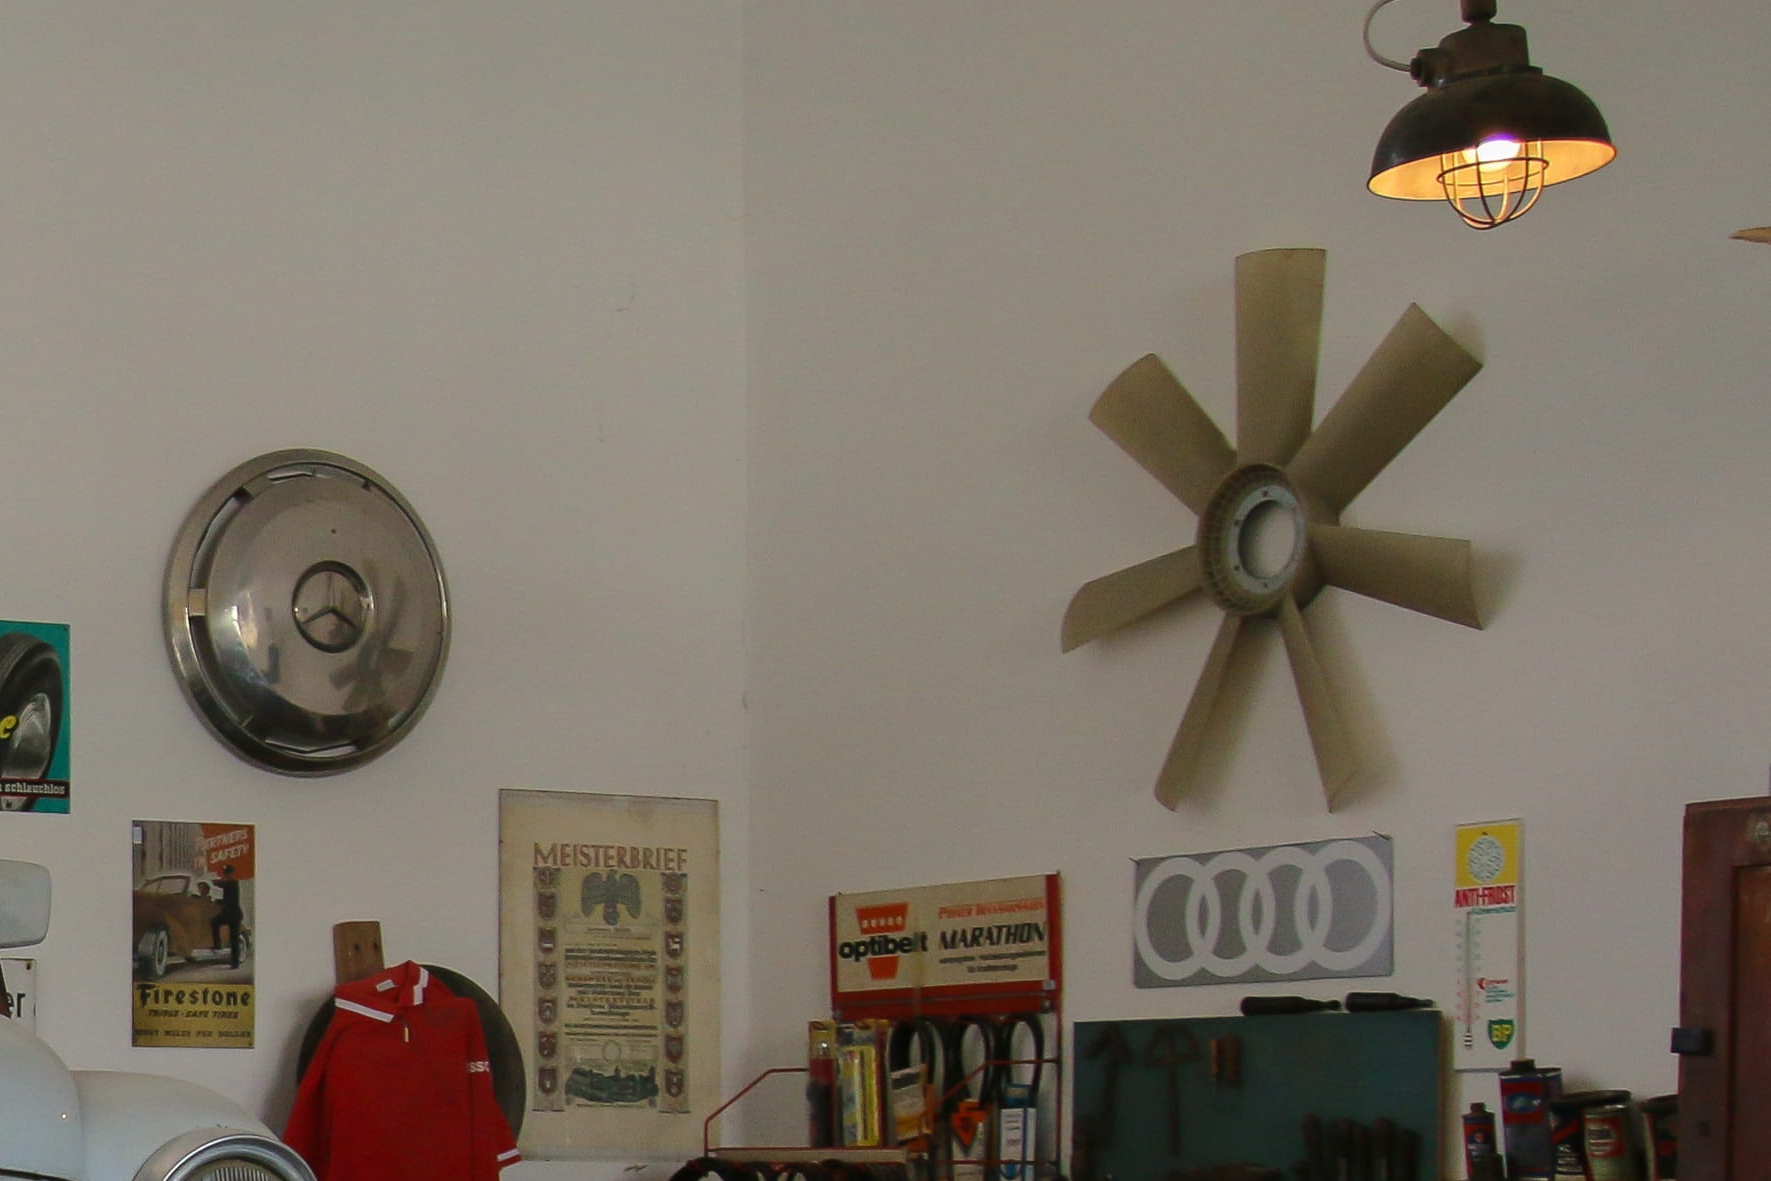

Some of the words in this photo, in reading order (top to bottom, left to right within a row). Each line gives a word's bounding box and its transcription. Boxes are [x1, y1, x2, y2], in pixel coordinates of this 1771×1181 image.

[4, 781, 66, 796] schlauchlos
[210, 843, 249, 864] SAFETY
[532, 842, 688, 872] MEISTERBRIEF
[1454, 885, 1516, 908] ANTI-FROST
[838, 931, 929, 962] optibelt
[938, 921, 1046, 951] MARATHON
[136, 983, 252, 1008] Firestone
[1491, 1023, 1513, 1042] BP
